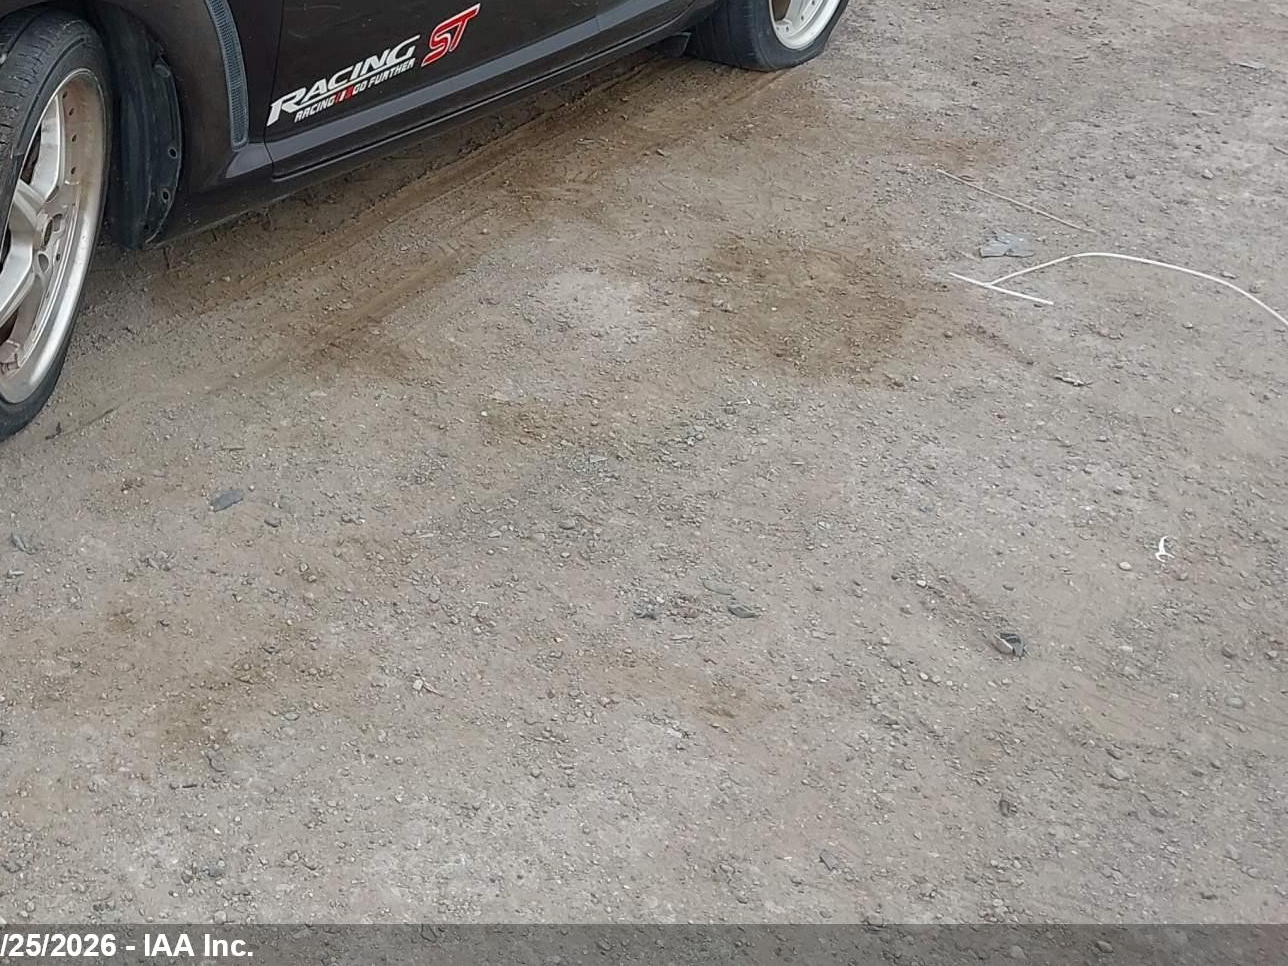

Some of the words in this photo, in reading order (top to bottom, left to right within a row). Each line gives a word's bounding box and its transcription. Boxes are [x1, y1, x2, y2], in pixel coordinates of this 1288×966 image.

[266, 34, 420, 127] RACING
[421, 2, 481, 67] ST
[294, 96, 336, 123] RACING
[367, 57, 416, 88] FURTHER
